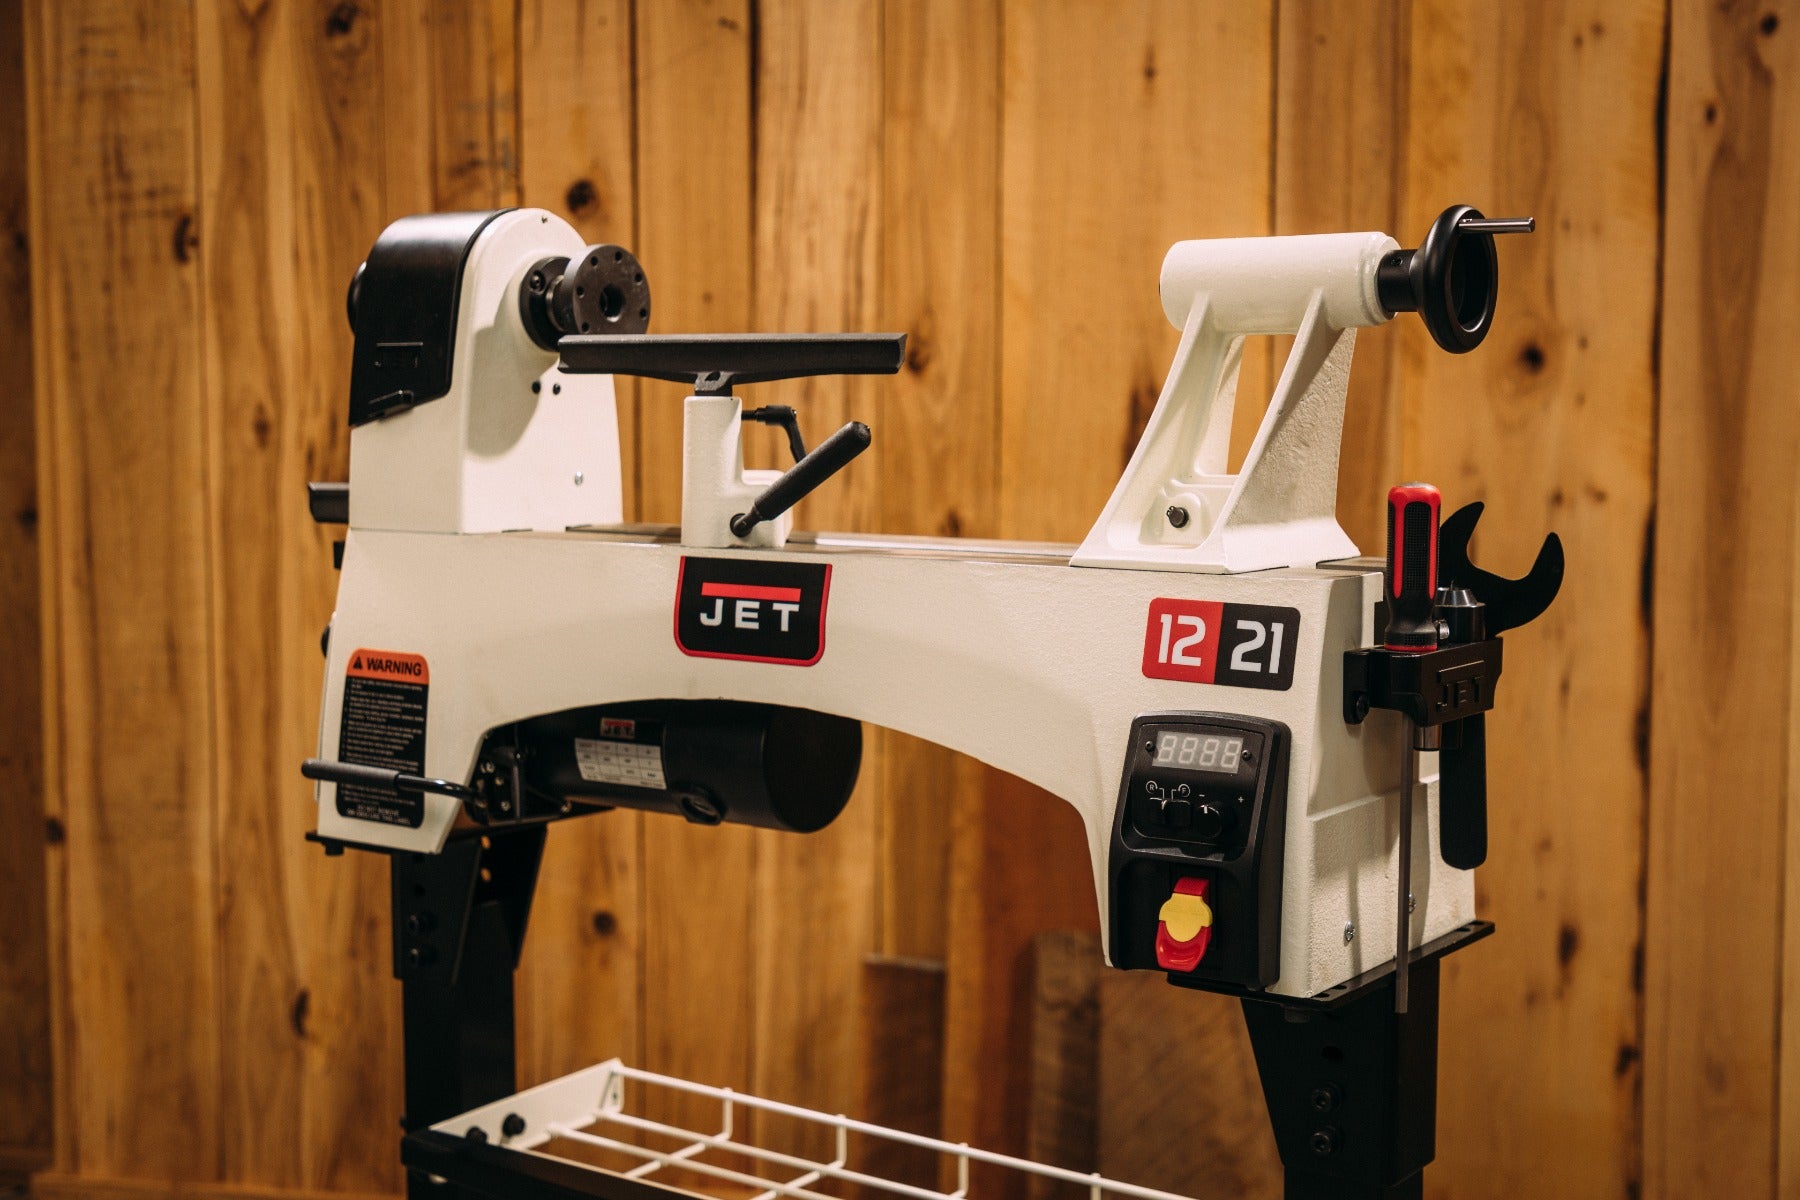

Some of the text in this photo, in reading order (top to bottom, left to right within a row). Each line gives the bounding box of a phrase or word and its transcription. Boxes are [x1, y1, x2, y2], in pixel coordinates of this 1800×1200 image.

[699, 598, 800, 632] JET
[1158, 613, 1284, 674] 12 21
[367, 657, 422, 676] WARNING
[1436, 676, 1484, 711] JET
